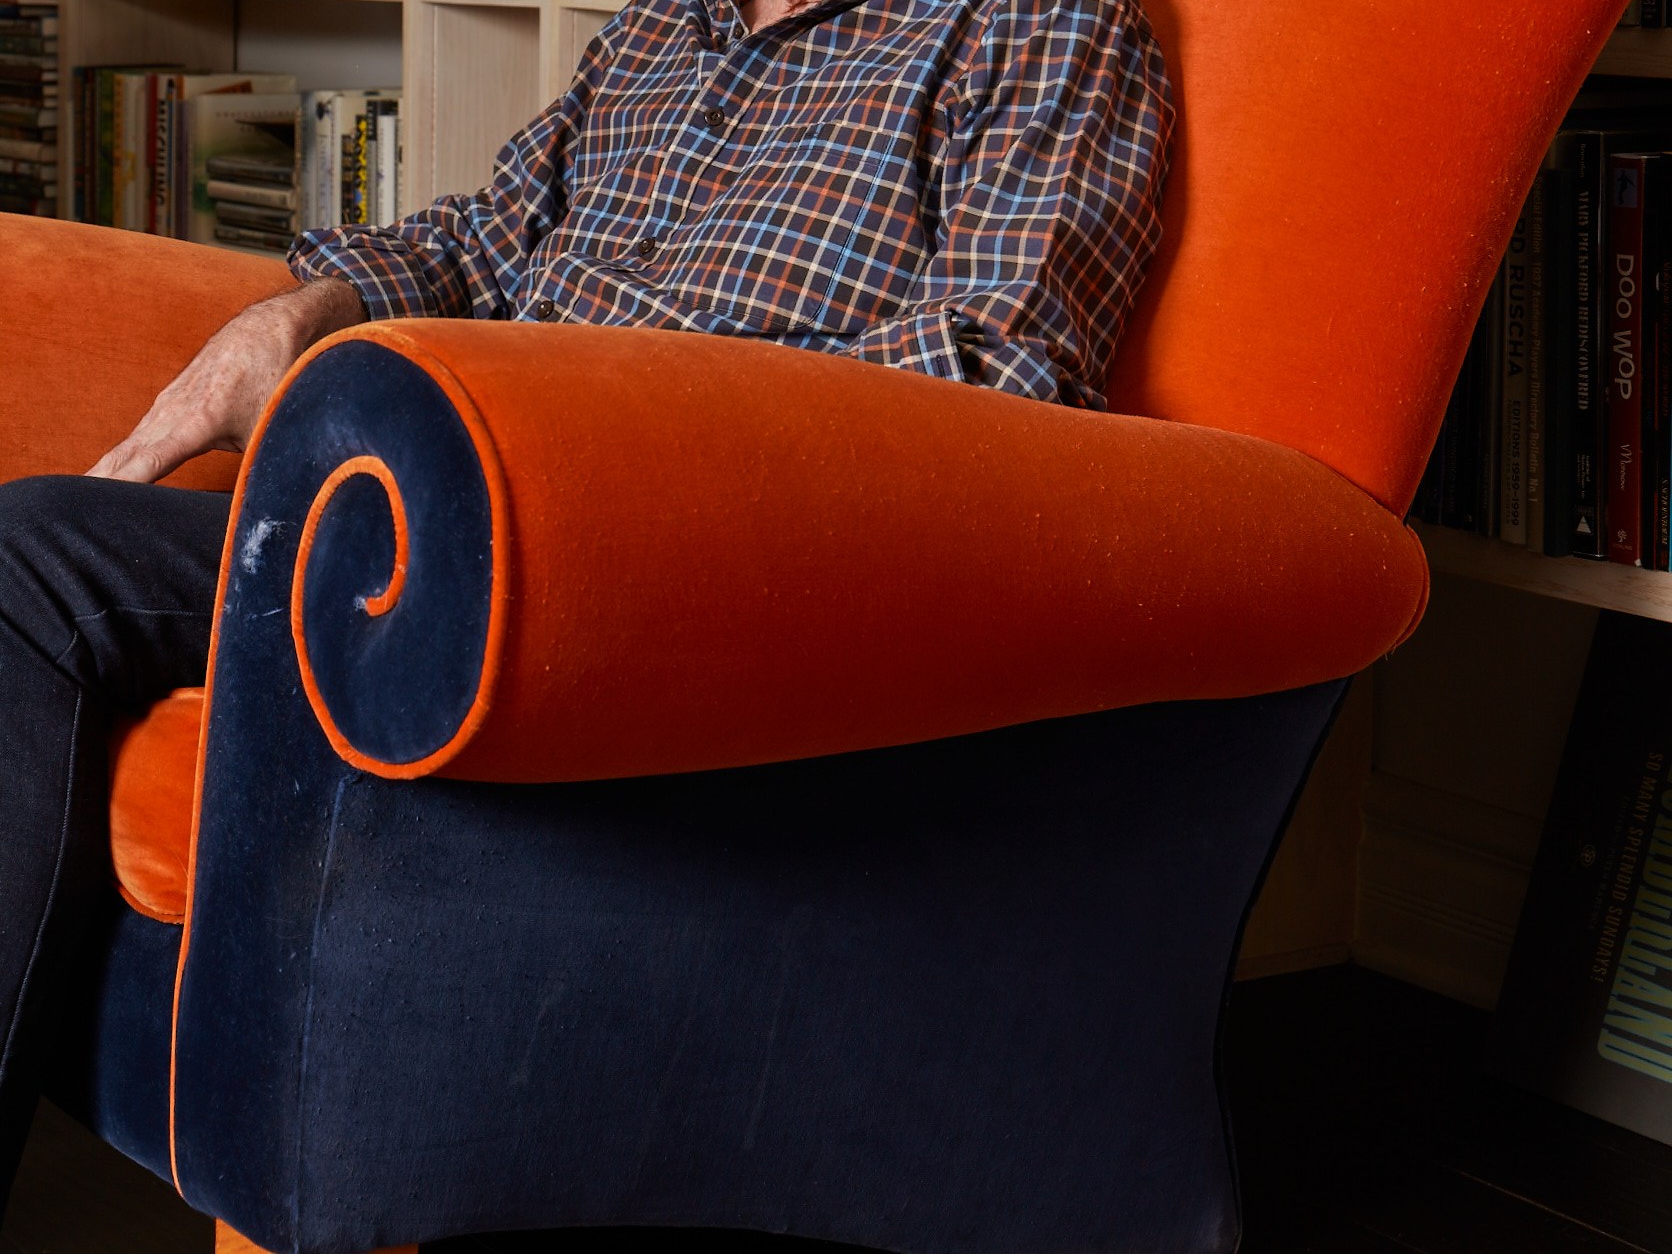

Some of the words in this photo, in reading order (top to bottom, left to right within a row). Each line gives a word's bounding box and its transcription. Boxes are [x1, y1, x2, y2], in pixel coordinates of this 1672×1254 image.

[1577, 190, 1591, 228] MARY
[1532, 216, 1543, 254] Edition
[1577, 232, 1591, 302] PICKFORD
[1615, 253, 1636, 320] DOO
[1530, 289, 1542, 336] Academy
[1529, 339, 1541, 380] Players
[1577, 305, 1590, 411] REDISCOVERED
[1612, 328, 1637, 402] WOP
[1511, 398, 1523, 458] EDITIONS
[1528, 381, 1541, 430] Directory
[1528, 433, 1540, 474] Bulletin
[1618, 443, 1633, 492] Morrow
[1510, 460, 1522, 527] 1959-1999
[1647, 751, 1665, 772] SO
[1631, 776, 1658, 823] MANY
[1611, 826, 1649, 903] SPLENDID
[1591, 906, 1626, 985] SUNDAYS!
